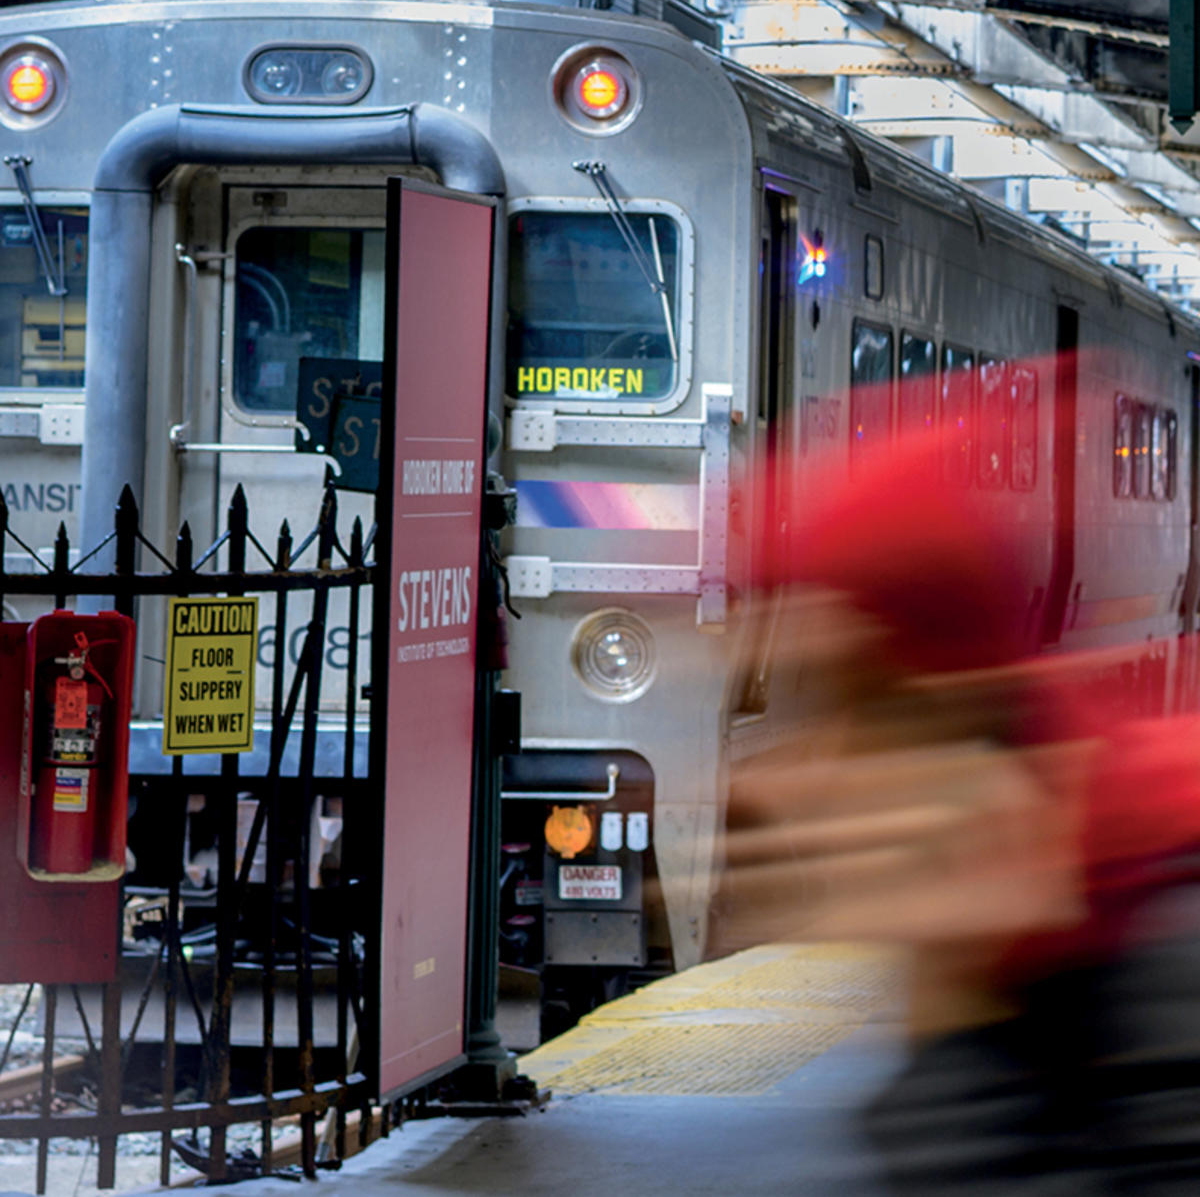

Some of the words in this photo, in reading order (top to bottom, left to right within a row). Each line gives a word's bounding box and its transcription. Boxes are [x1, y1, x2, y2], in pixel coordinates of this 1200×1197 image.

[518, 367, 643, 394] HOBOKEN
[4, 483, 82, 512] ANSI
[398, 566, 471, 632] STEVENS
[175, 604, 253, 635] CAUTION
[191, 648, 234, 668] FLOOR
[179, 680, 243, 701] SLIPPERY
[175, 714, 214, 734] WHEN
[217, 713, 244, 733] WET
[562, 866, 617, 881] DANGER
